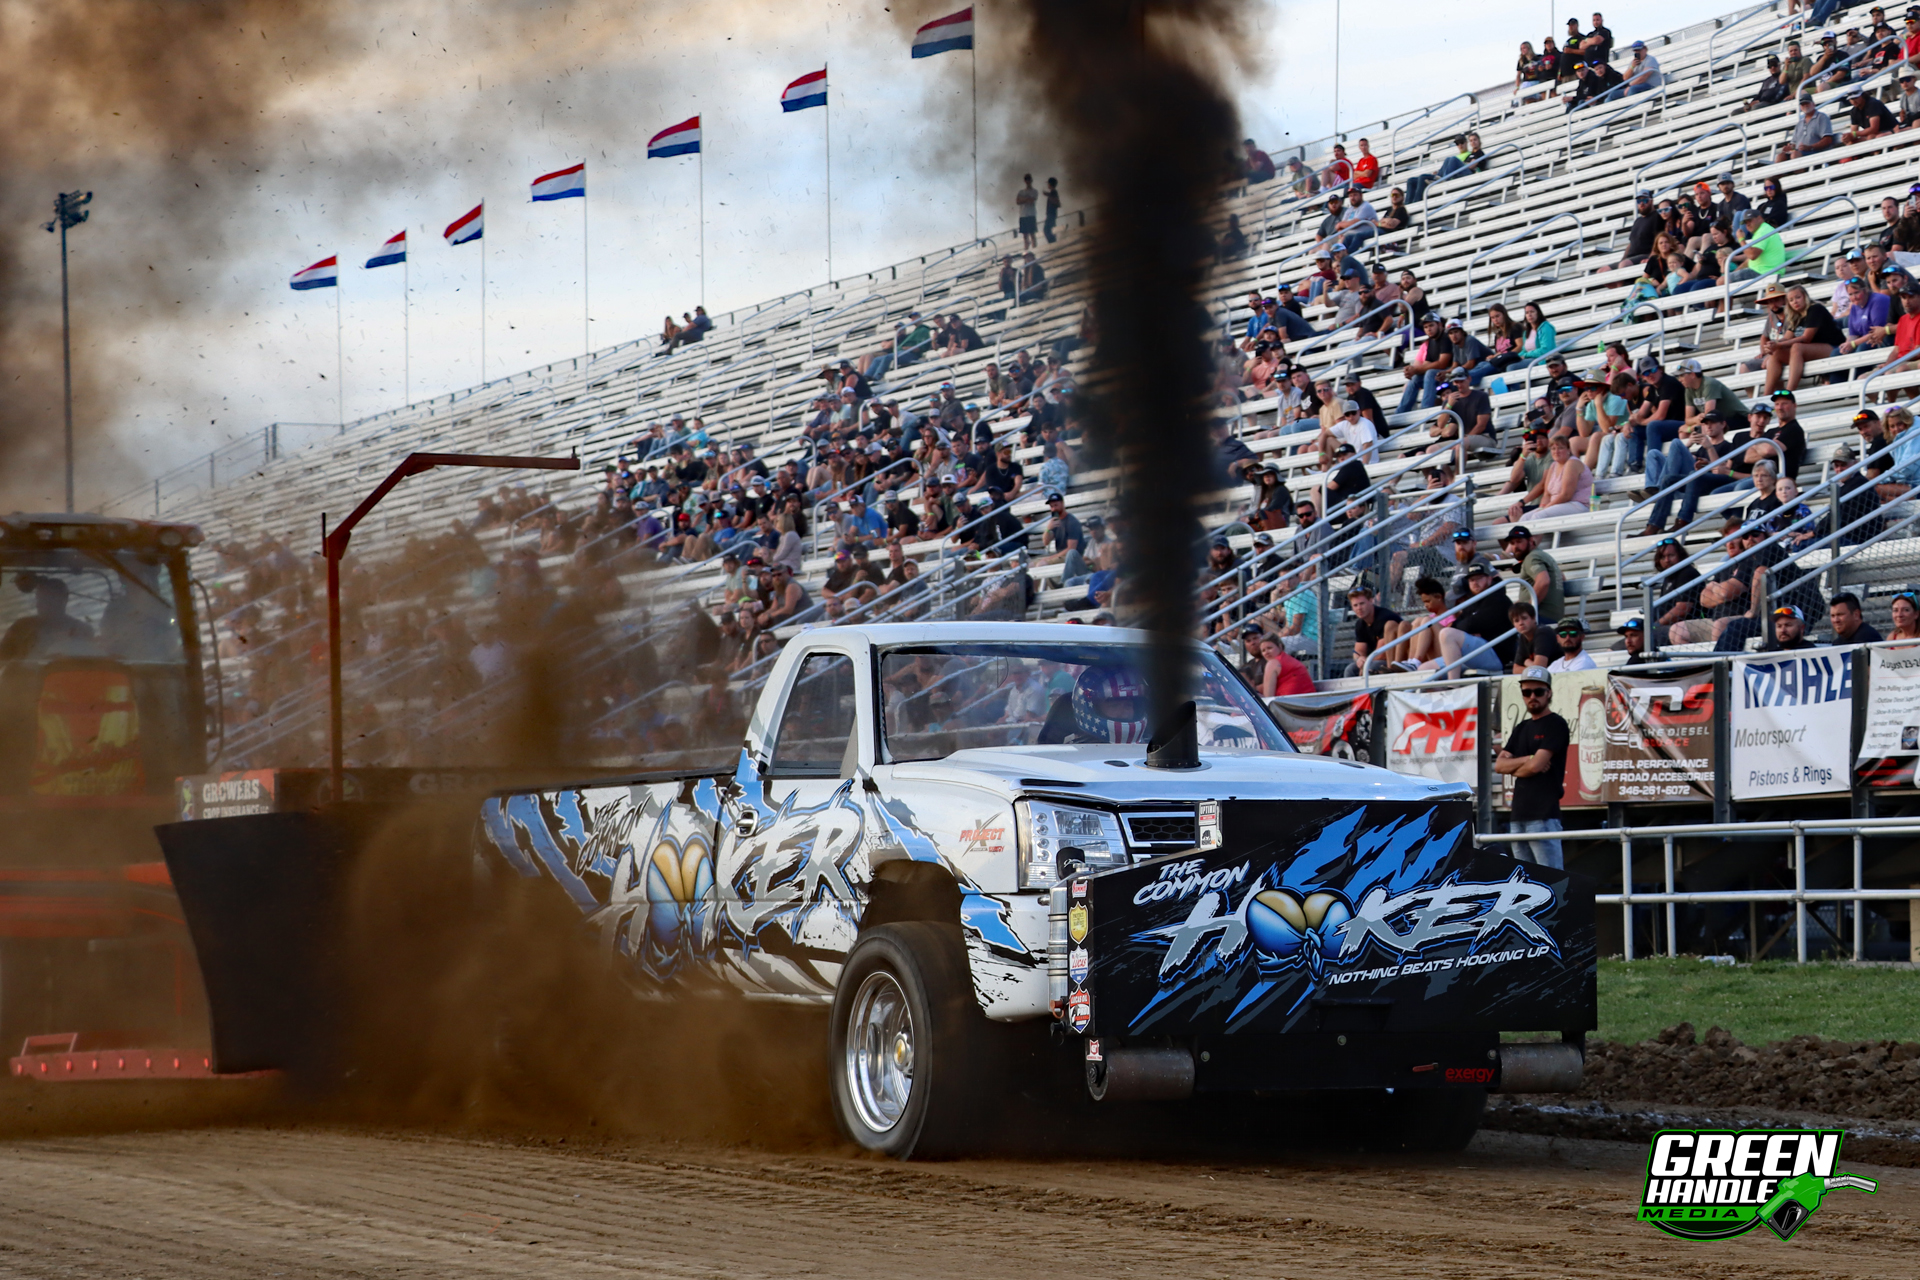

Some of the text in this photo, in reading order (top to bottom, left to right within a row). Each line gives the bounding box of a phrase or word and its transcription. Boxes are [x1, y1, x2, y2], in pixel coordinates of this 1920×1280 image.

[1744, 652, 1852, 709] MAHLE
[1392, 708, 1478, 754] PPE
[1643, 727, 1709, 737] THE DIESEL
[1734, 725, 1806, 748] Motorsport
[1643, 738, 1690, 747] SOURCE
[1603, 759, 1709, 770] DIESEL PERFORMANCE
[1620, 773, 1650, 782] ROAD
[1651, 772, 1715, 781] ACCESSORIES
[1749, 766, 1832, 786] Pistons & Rings
[203, 779, 259, 803] GROWERS
[1618, 785, 1690, 795] 346-261-6072
[959, 828, 1005, 842] PROJECT
[1159, 859, 1205, 880] THE
[1133, 860, 1250, 905] COMMON
[1329, 946, 1549, 985] NOTHING BEATS HOOKING UP
[1445, 1068, 1495, 1083] exergy
